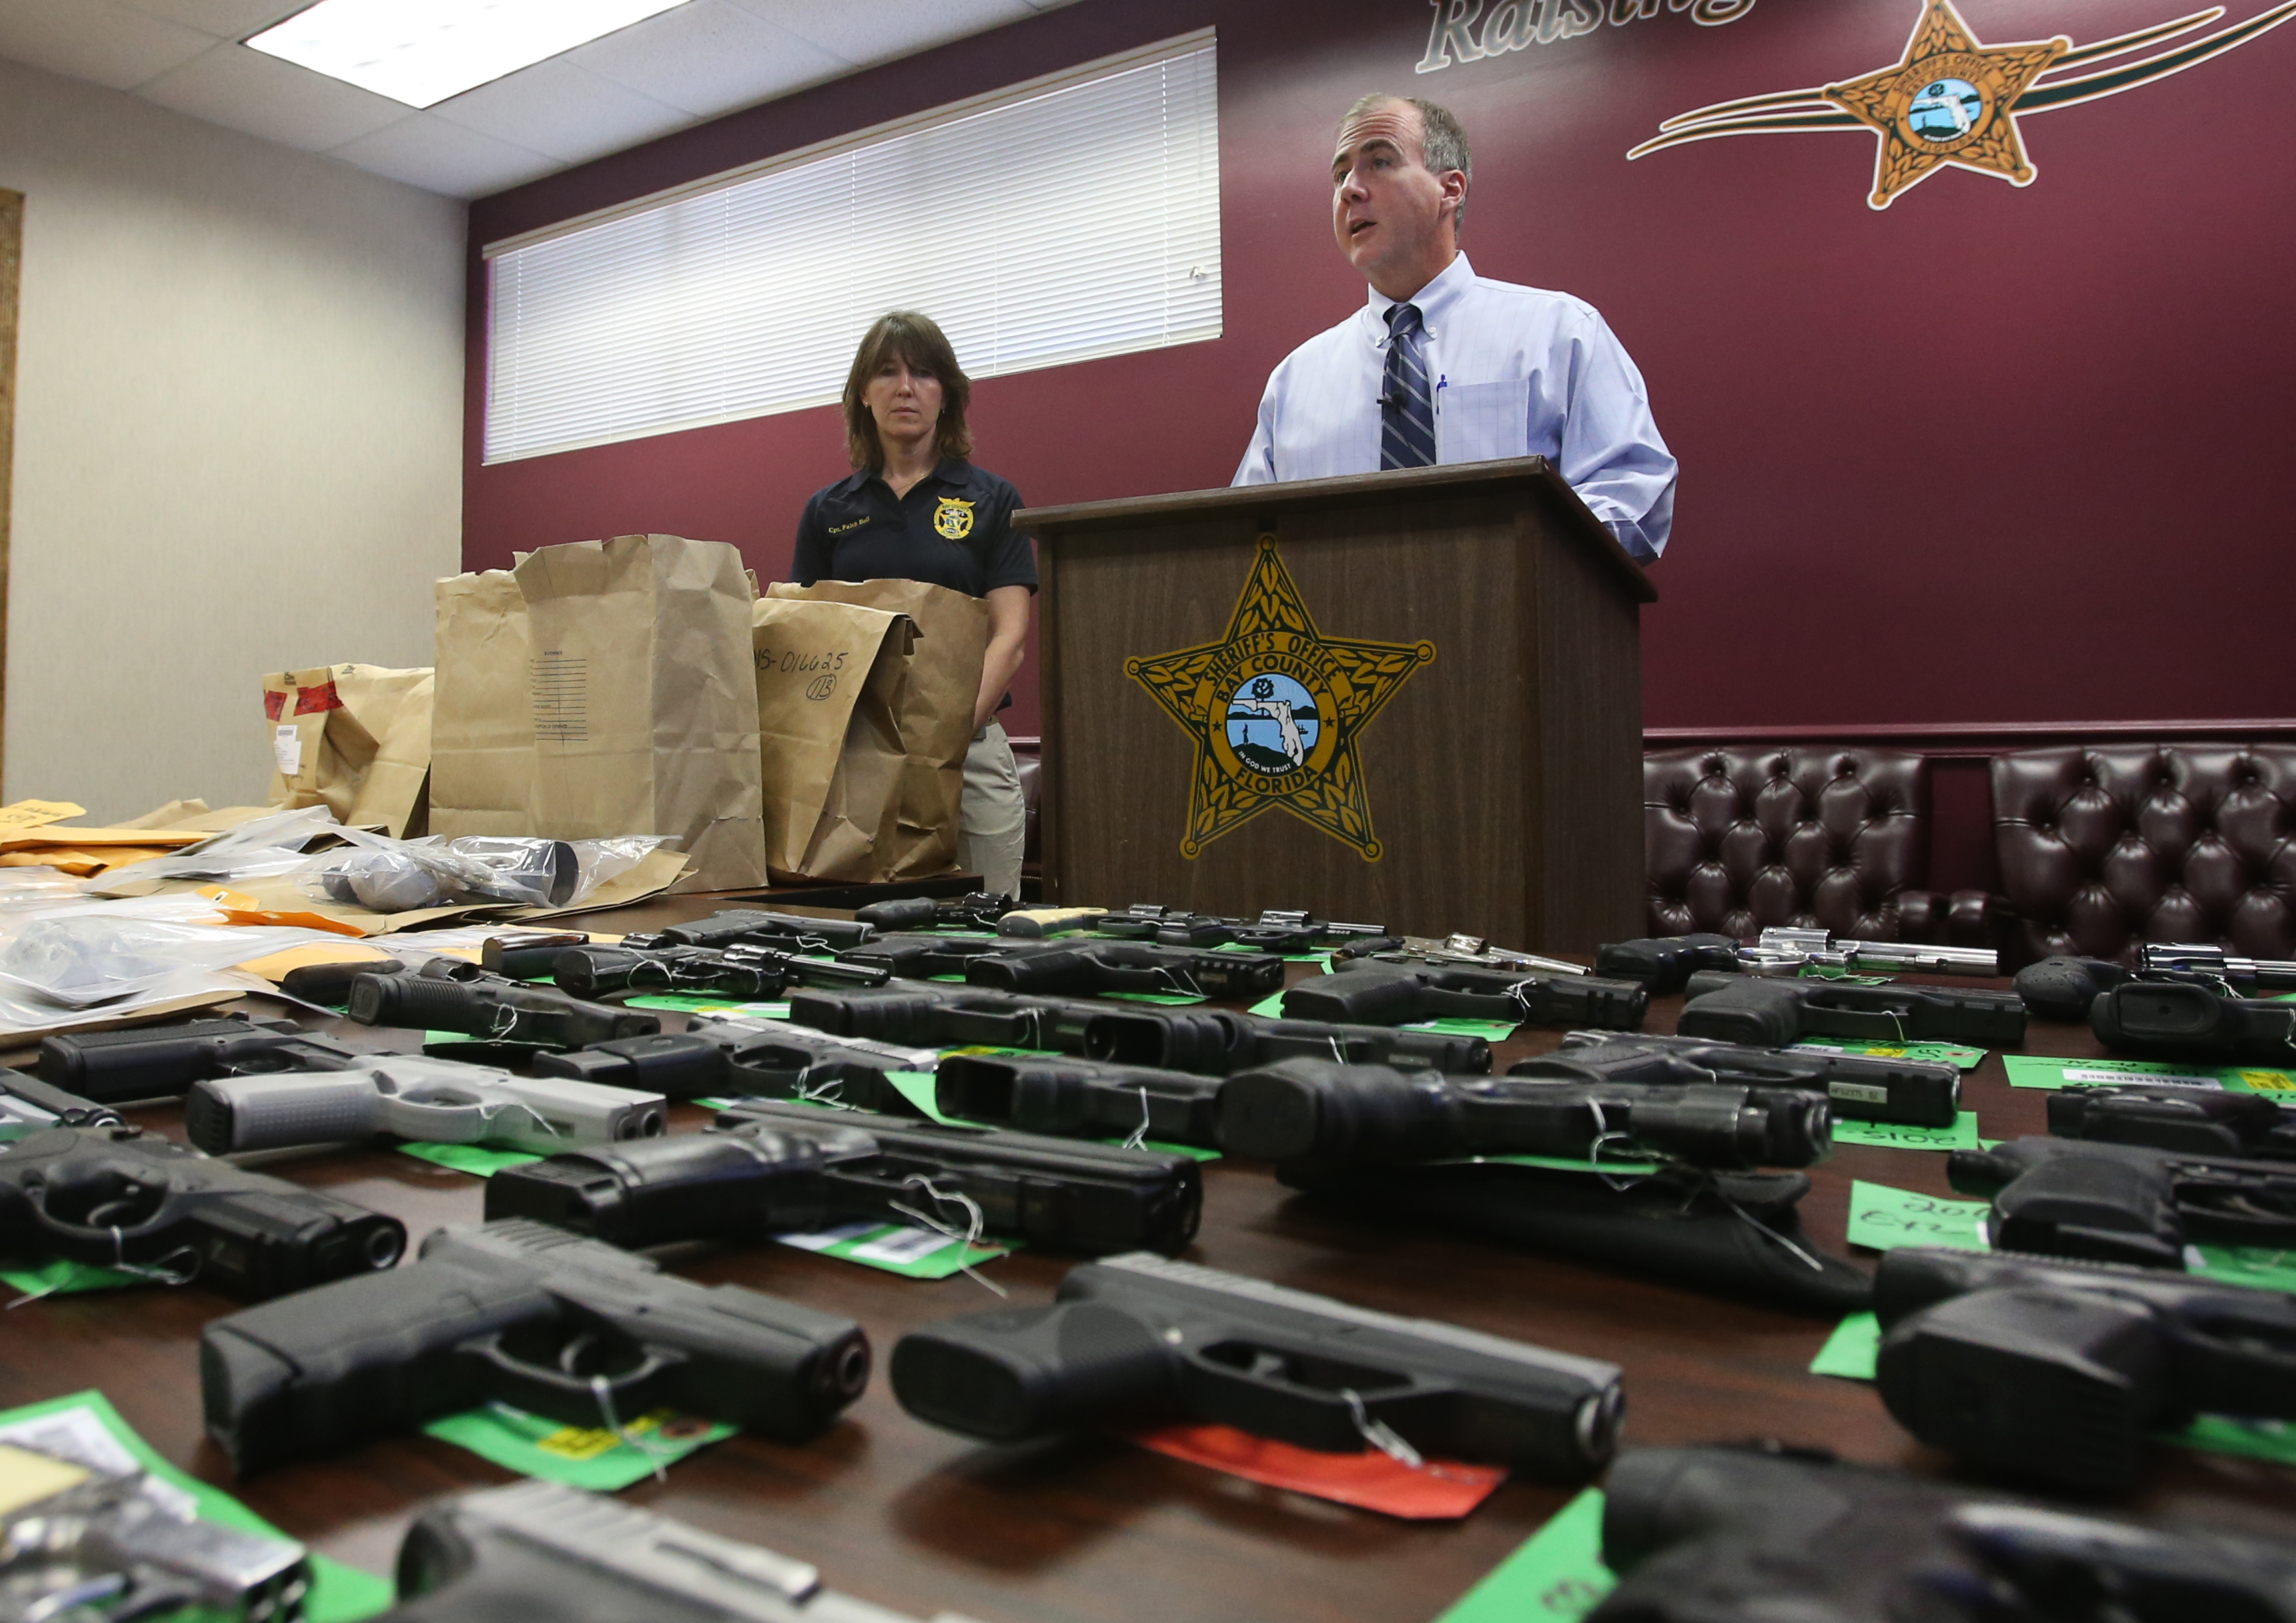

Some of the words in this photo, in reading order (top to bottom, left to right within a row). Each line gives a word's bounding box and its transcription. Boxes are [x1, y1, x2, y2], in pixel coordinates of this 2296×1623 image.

[1415, 0, 1757, 73] Rais
[753, 648, 849, 672] 15-016625
[1204, 632, 1276, 687] SHERIFF'S
[1288, 635, 1342, 682] OFFICE
[1216, 666, 1244, 704] BAY
[1251, 654, 1330, 697] COUNTY
[1234, 764, 1318, 794] FLORIDA
[1238, 750, 1246, 760] IN
[1245, 758, 1260, 770] GOD
[1272, 763, 1292, 773] TRUST
